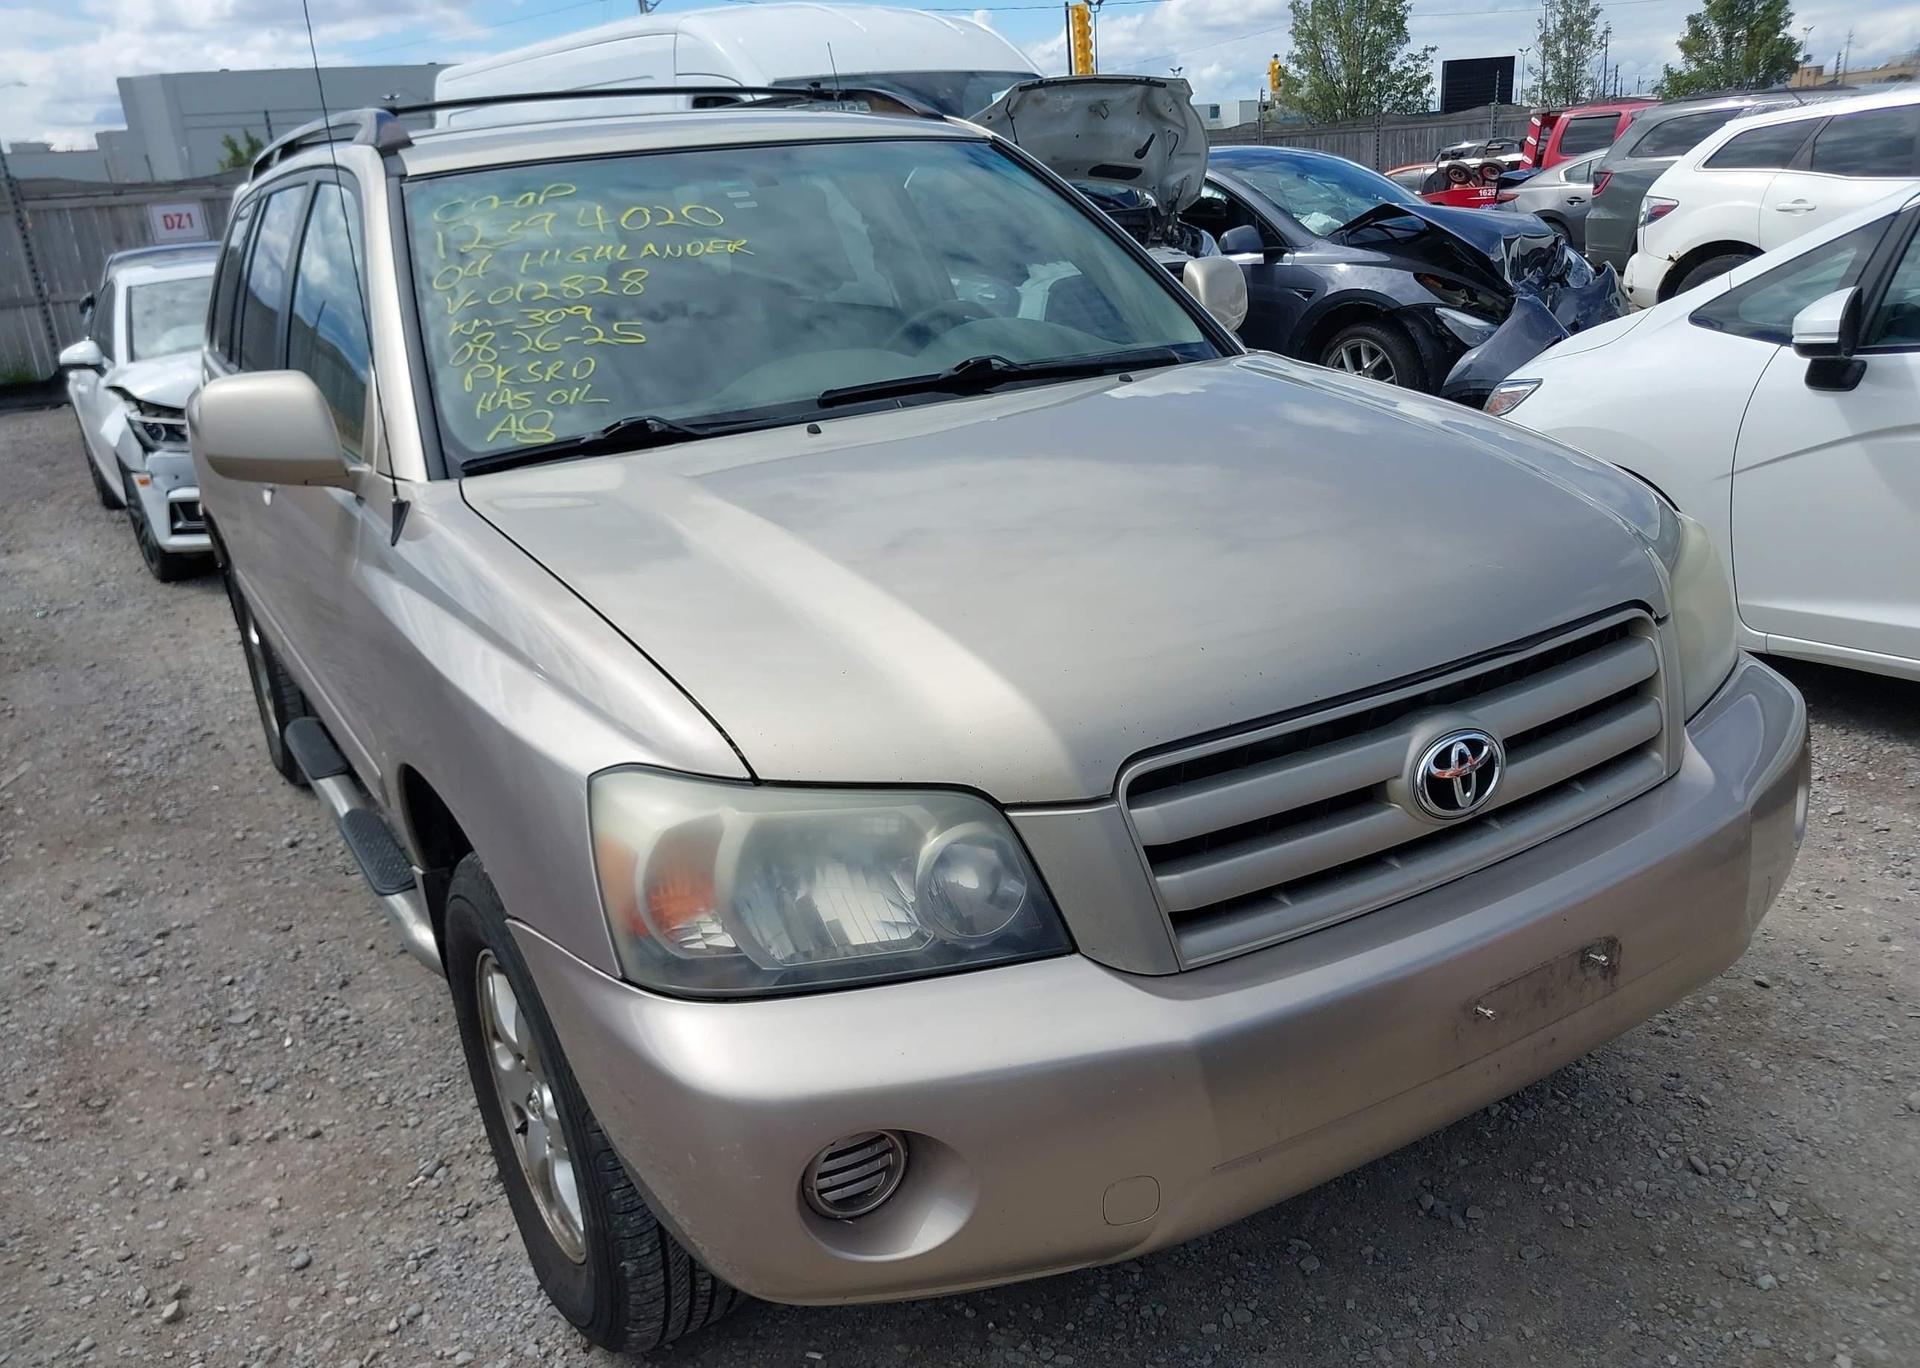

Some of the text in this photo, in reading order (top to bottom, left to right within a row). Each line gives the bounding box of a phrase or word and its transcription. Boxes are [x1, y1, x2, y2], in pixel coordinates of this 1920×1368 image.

[162, 211, 195, 231] DZ1
[576, 204, 724, 235] 4020
[519, 239, 755, 275] HIGHLANDER
[449, 320, 647, 367] 08-26-25
[476, 383, 610, 420] HAS OIL
